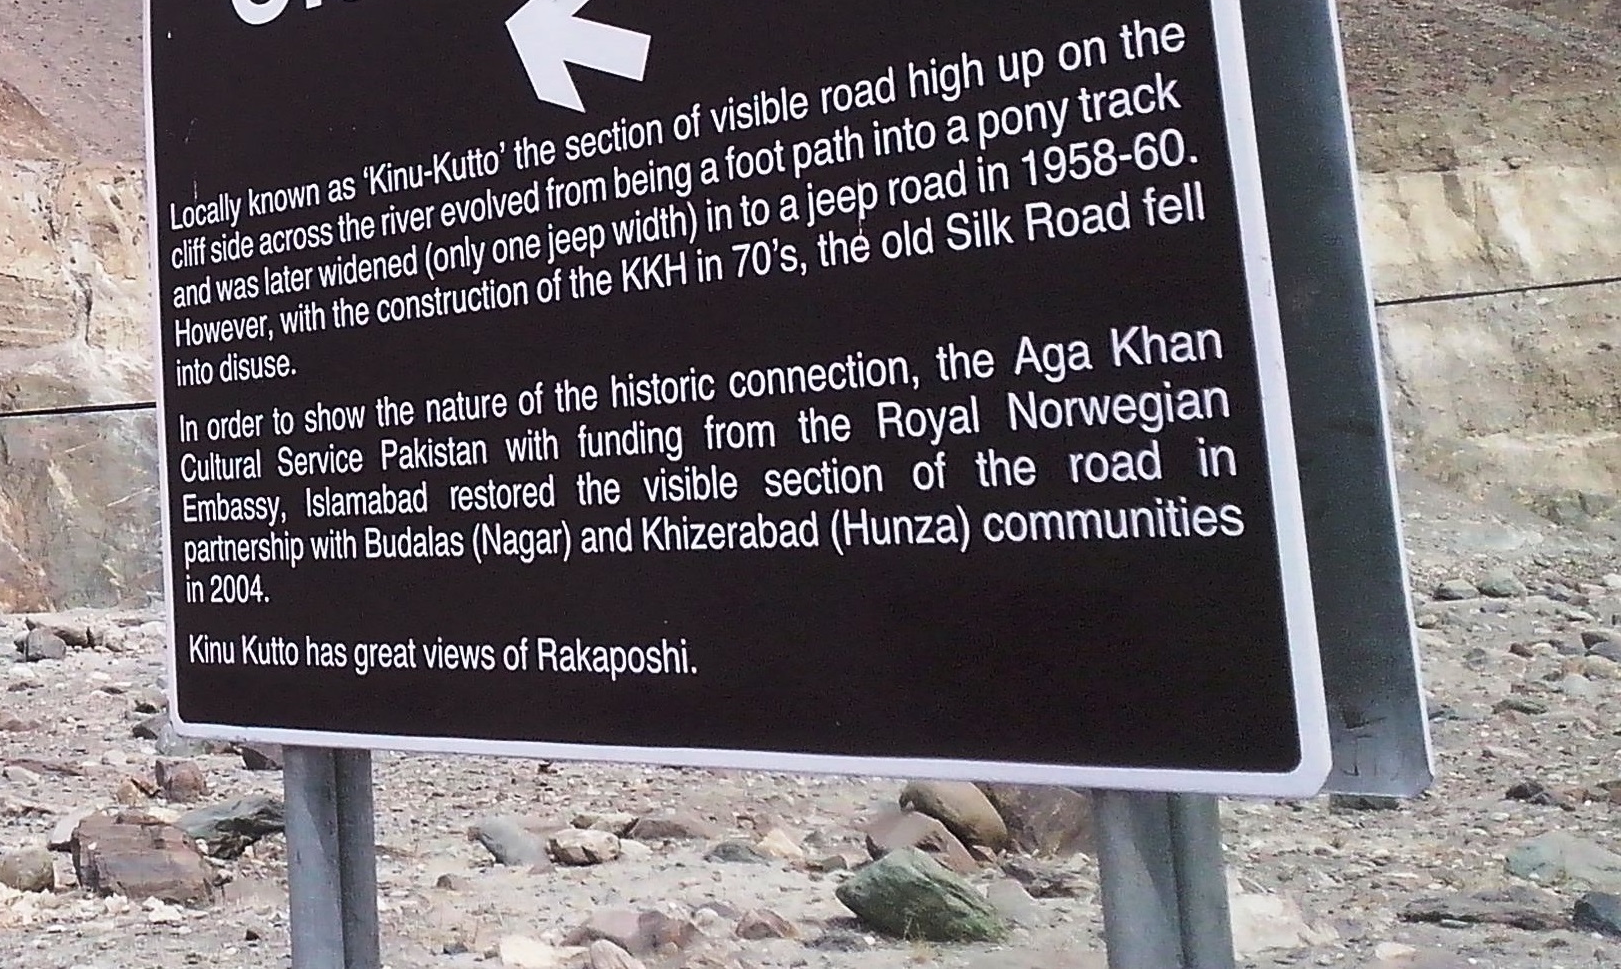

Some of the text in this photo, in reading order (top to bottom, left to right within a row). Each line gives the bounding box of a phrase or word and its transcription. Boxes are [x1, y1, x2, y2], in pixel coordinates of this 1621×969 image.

[170, 19, 1185, 230] Locally known as ‘Kinu-Kutto’ the section of visible road high up on the
[171, 72, 1181, 269] cliff side across the river evolved from being a foot path into a pony track
[173, 128, 1198, 309] and was later widened (only one jeep width) in to a jeep road in 1958-60.
[175, 180, 1206, 348] However, with the construction of the KKH in 70’s, the old Silk Road fell
[176, 352, 297, 387] into disuse.
[179, 325, 1223, 443] In order to show the nature of the historic connection, the Aga Khan
[180, 381, 1230, 483] Cultural Service Pakistan with funding from the Royal Norwegian
[182, 437, 1237, 527] Embassy, Islamabad restored the visible section of the road in
[184, 496, 1245, 570] partnership with Budalas (Nagar) and Khizerabad (Hunza) communities
[185, 573, 270, 604] in 2004.
[189, 634, 697, 682] Kinu Kutto has great views of Rakaposhi.
